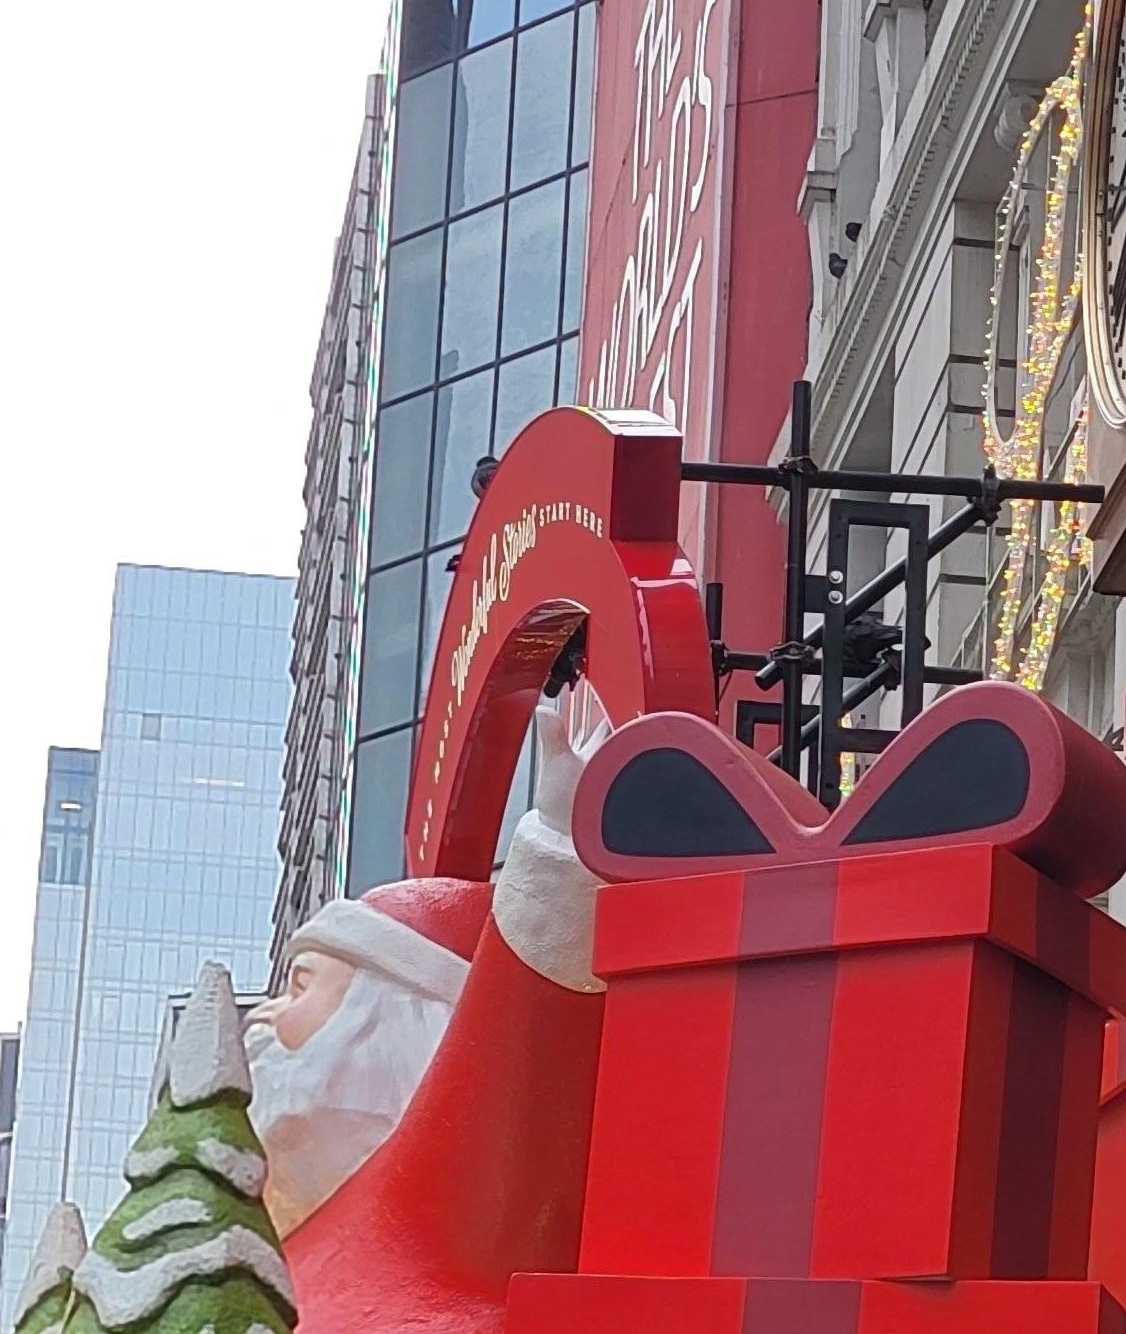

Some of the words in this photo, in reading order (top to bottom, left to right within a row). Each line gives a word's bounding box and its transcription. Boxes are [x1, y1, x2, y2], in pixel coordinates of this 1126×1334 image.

[451, 533, 498, 707] Wonderful
[499, 503, 538, 602] Stories
[539, 502, 571, 528] START
[575, 504, 604, 539] HERE
